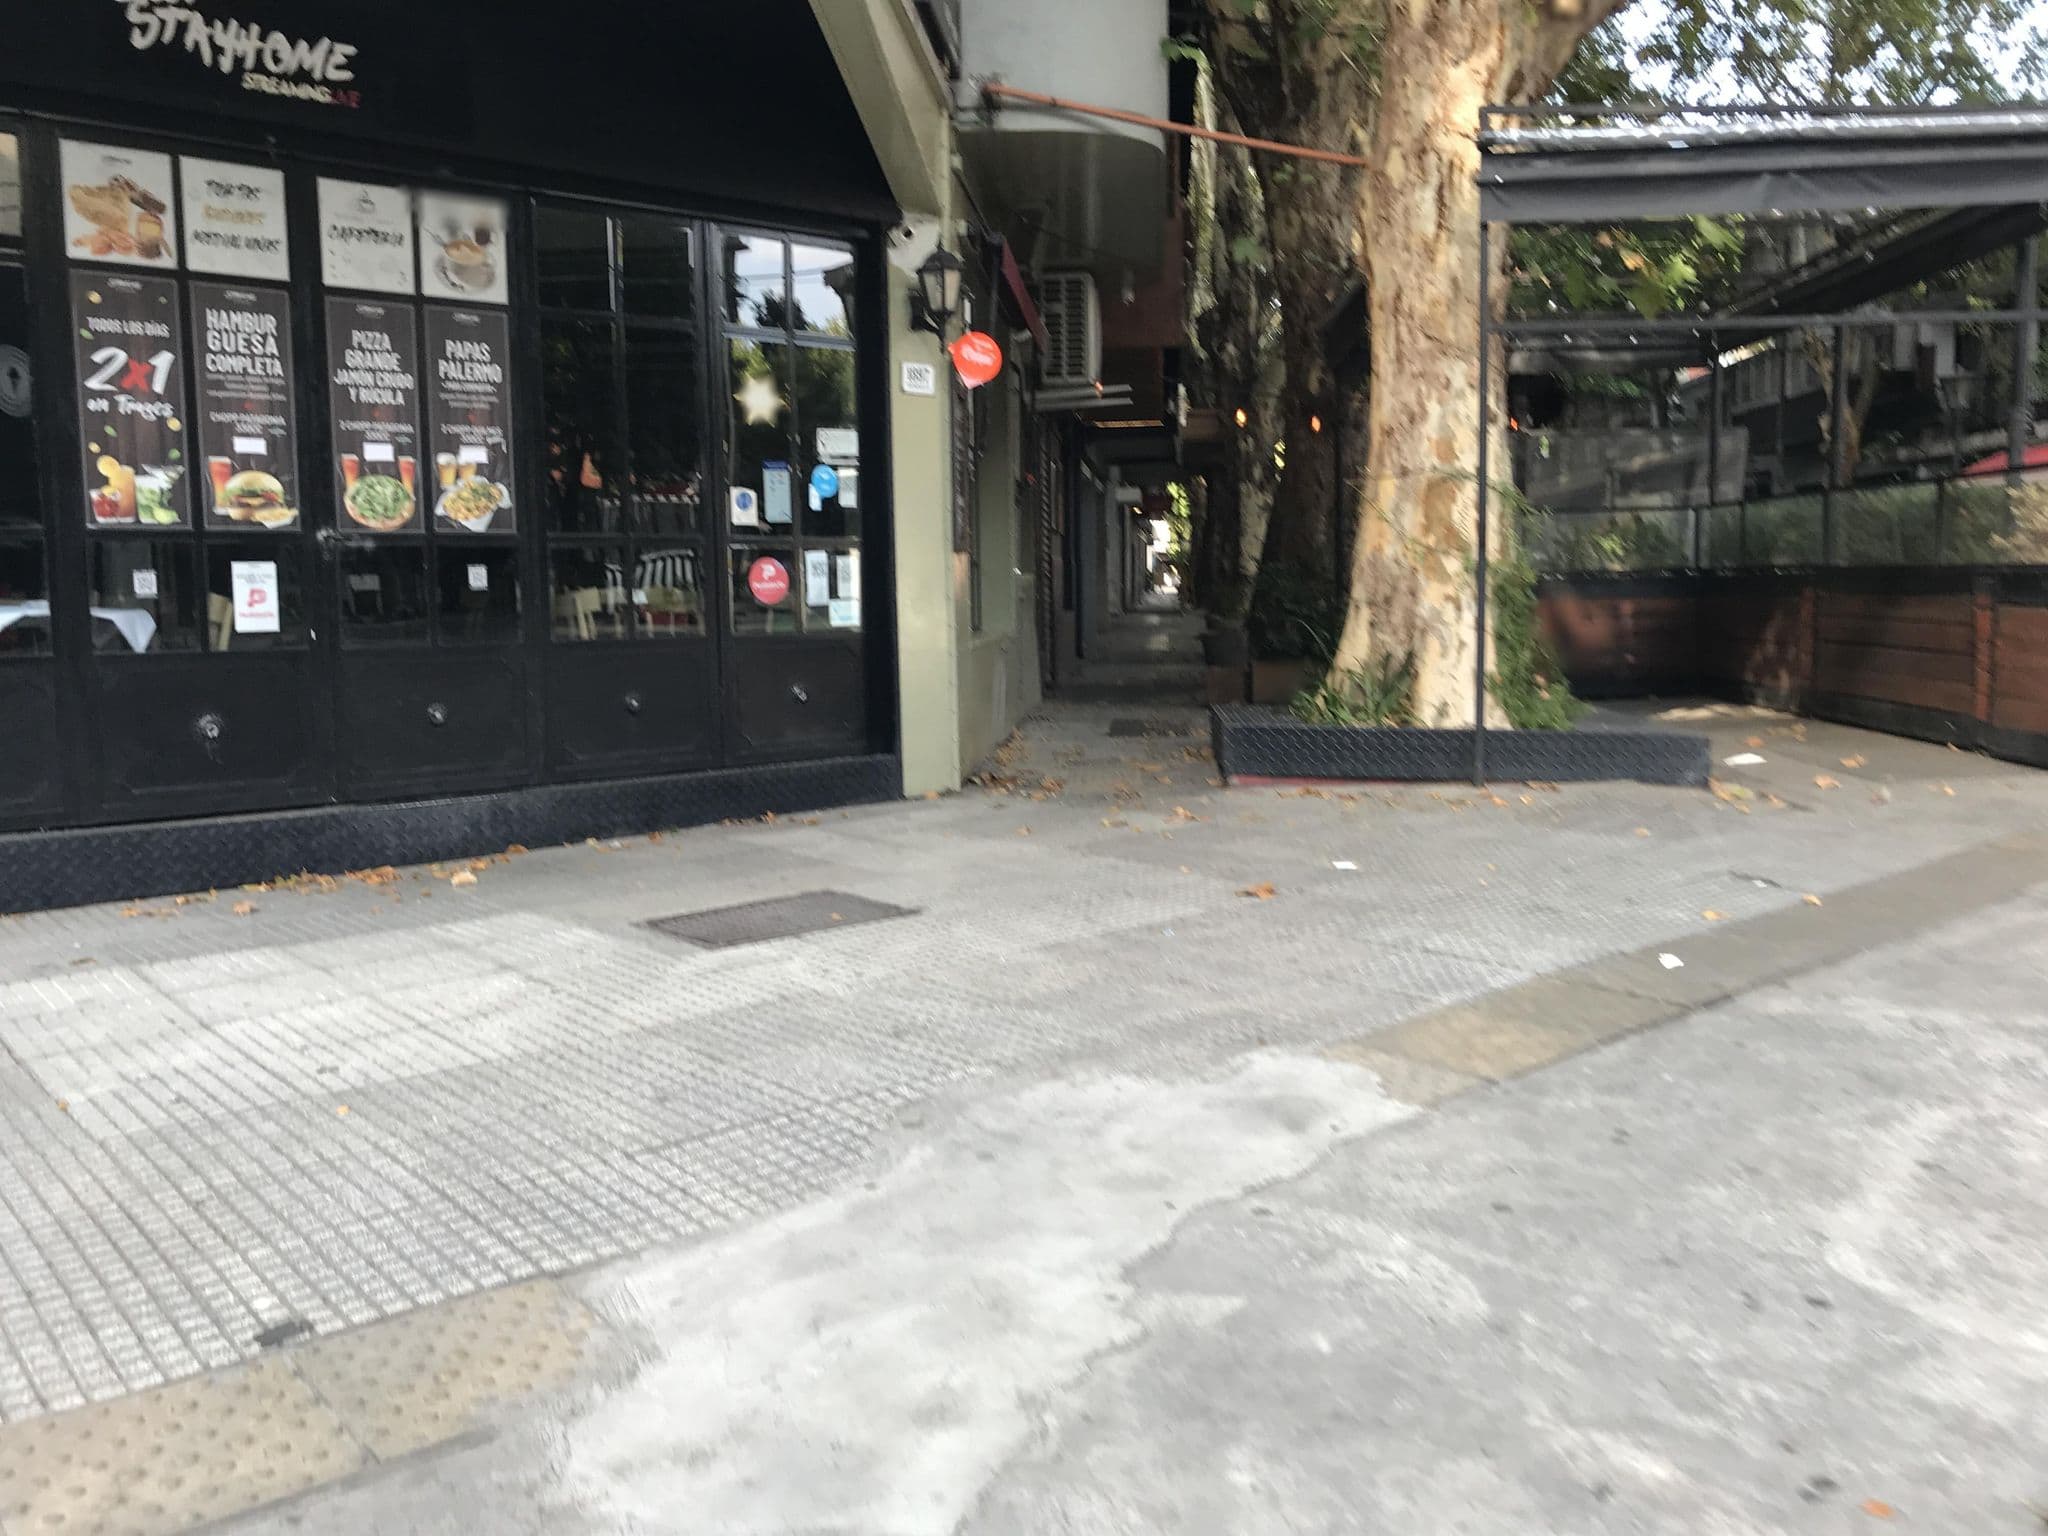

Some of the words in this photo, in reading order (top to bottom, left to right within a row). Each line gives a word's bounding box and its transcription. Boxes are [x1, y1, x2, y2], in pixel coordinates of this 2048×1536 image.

[125, 2, 358, 81] STAYHOME
[87, 316, 122, 334] TODOS
[122, 320, 144, 335] LOS
[205, 307, 278, 336] HAMBUR
[207, 329, 280, 357] GUESA
[351, 330, 393, 352] PIZZA
[445, 339, 491, 362] PAPAS
[205, 352, 285, 377] COMPLETA
[344, 349, 402, 372] GRANDE
[438, 359, 503, 384] PALERMO
[375, 371, 415, 390] CRUDO
[348, 386, 358, 403] Y
